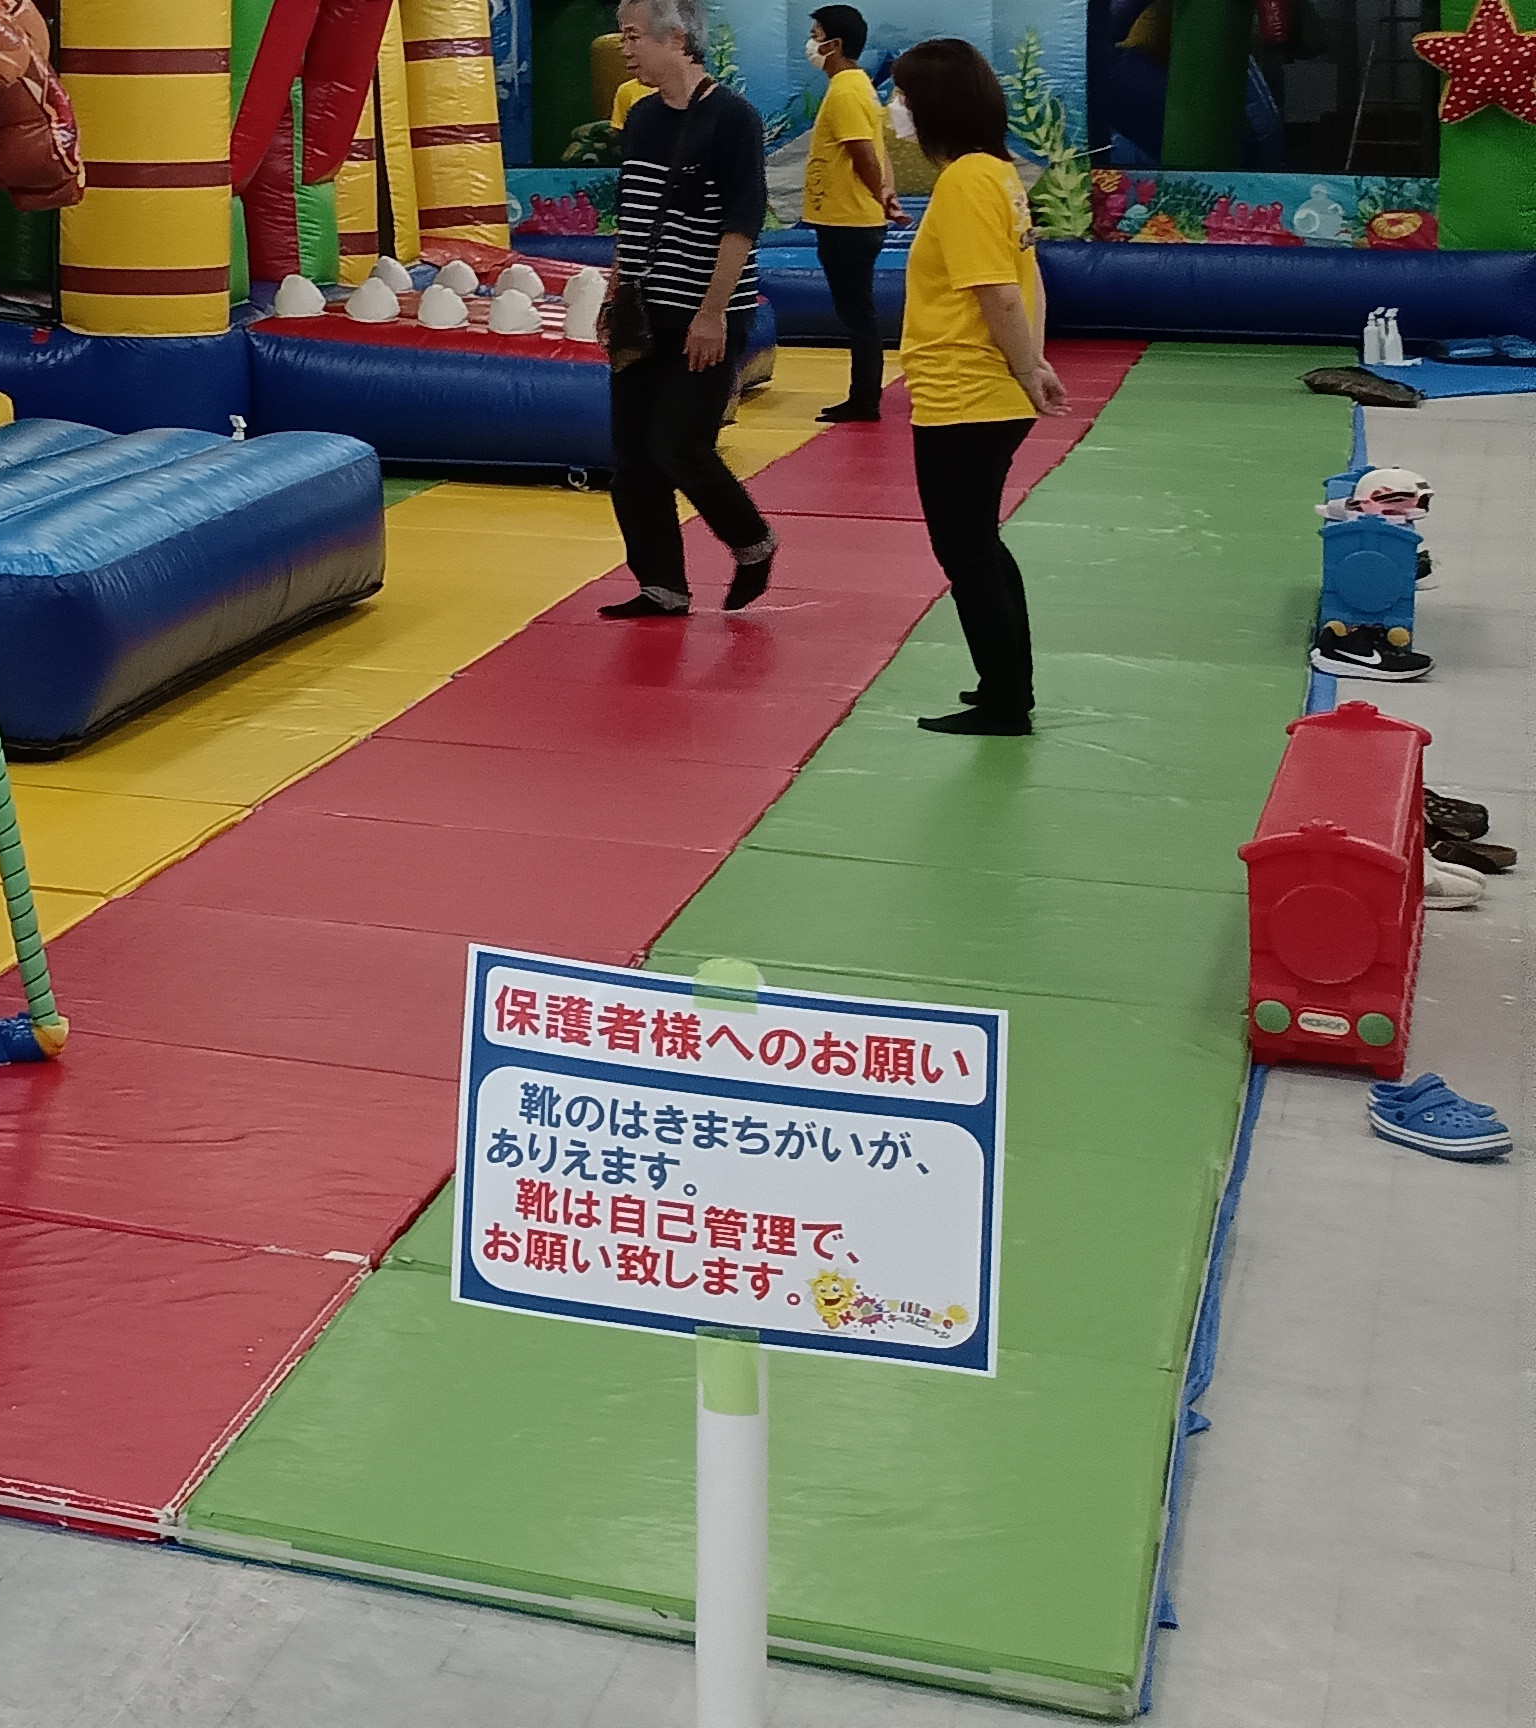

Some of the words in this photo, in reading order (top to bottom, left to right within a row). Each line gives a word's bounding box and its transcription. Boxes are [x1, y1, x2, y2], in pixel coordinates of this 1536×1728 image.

[494, 985, 970, 1086] 保護者様へのお願い
[486, 1128, 699, 1197] ありえます。
[519, 1082, 931, 1176] 靴のはきまちがいが、
[482, 1223, 804, 1307] お願い致します。
[515, 1177, 861, 1265] 靴は自己管理で、
